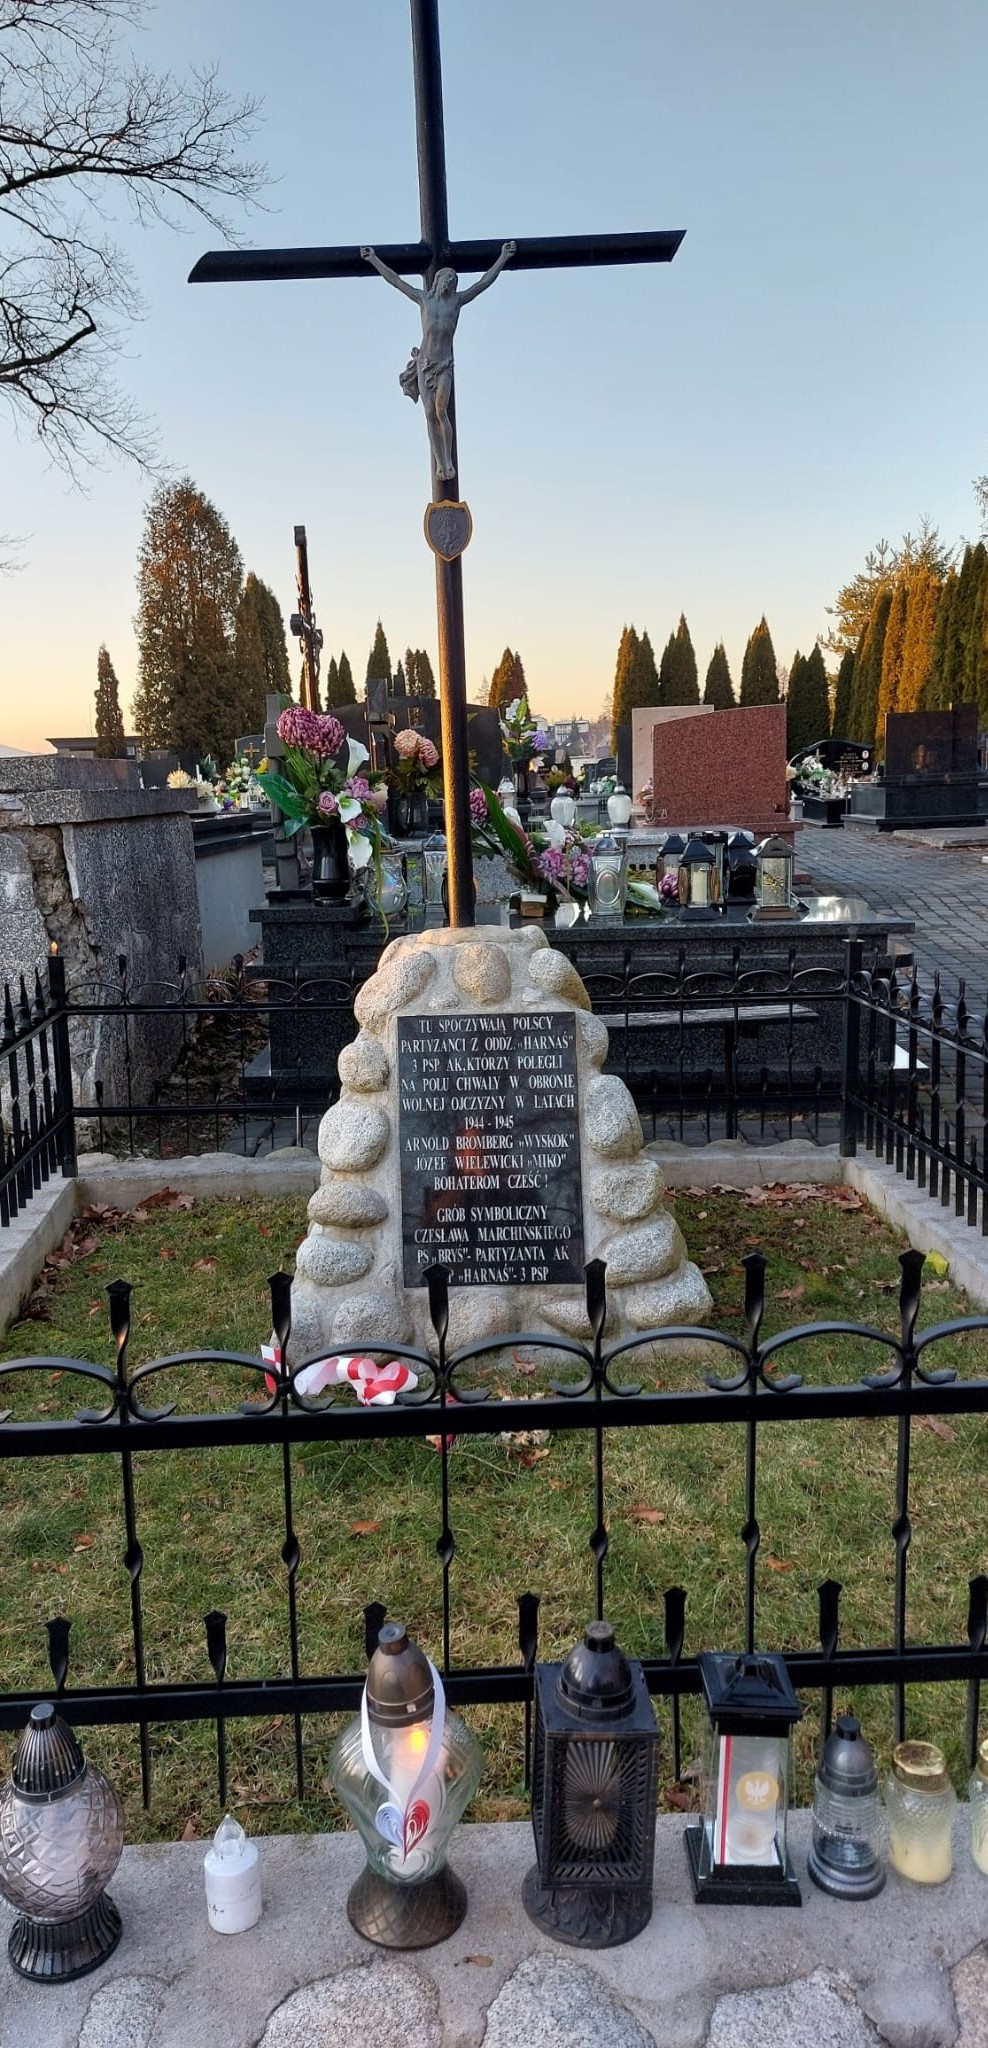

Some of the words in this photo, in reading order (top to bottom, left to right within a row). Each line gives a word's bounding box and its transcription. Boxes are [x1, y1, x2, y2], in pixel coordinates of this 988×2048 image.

[419, 1020, 432, 1033] TU
[439, 1018, 506, 1036] SPOCZYWAJĄ
[513, 1016, 554, 1030] POLSCY
[401, 1039, 466, 1053] PARTYZANCI
[471, 1038, 478, 1051] Z
[412, 1059, 417, 1072] 3
[423, 1058, 439, 1072] PSP
[518, 1055, 562, 1069] POLEGLI
[401, 1079, 416, 1092] NA
[423, 1078, 449, 1091] POLU
[510, 1076, 520, 1088] W
[529, 1074, 575, 1089] OBRONIE
[403, 1098, 445, 1112] WOLNEJ
[452, 1096, 507, 1111] OJCZYZNY
[515, 1096, 524, 1109] W
[534, 1094, 575, 1109] LATACH
[465, 1116, 484, 1130] 1944
[495, 1115, 514, 1129] 1945
[405, 1136, 449, 1152] ARNOLD
[456, 1135, 513, 1150] BROMBERG
[415, 1153, 447, 1171] JÓZEF
[455, 1154, 523, 1169] WIELEWICKI
[434, 1174, 499, 1191] BOHATEROM
[437, 1204, 465, 1223] GRÓB
[470, 1205, 548, 1222] SYMBOLICZNY
[478, 1222, 571, 1242] MARCHIŃSKIEGO
[417, 1250, 430, 1264] PS
[476, 1247, 545, 1262] PARTYZANTA
[553, 1246, 569, 1260] AK
[521, 1269, 526, 1282] 3
[531, 1267, 548, 1281] PSP
